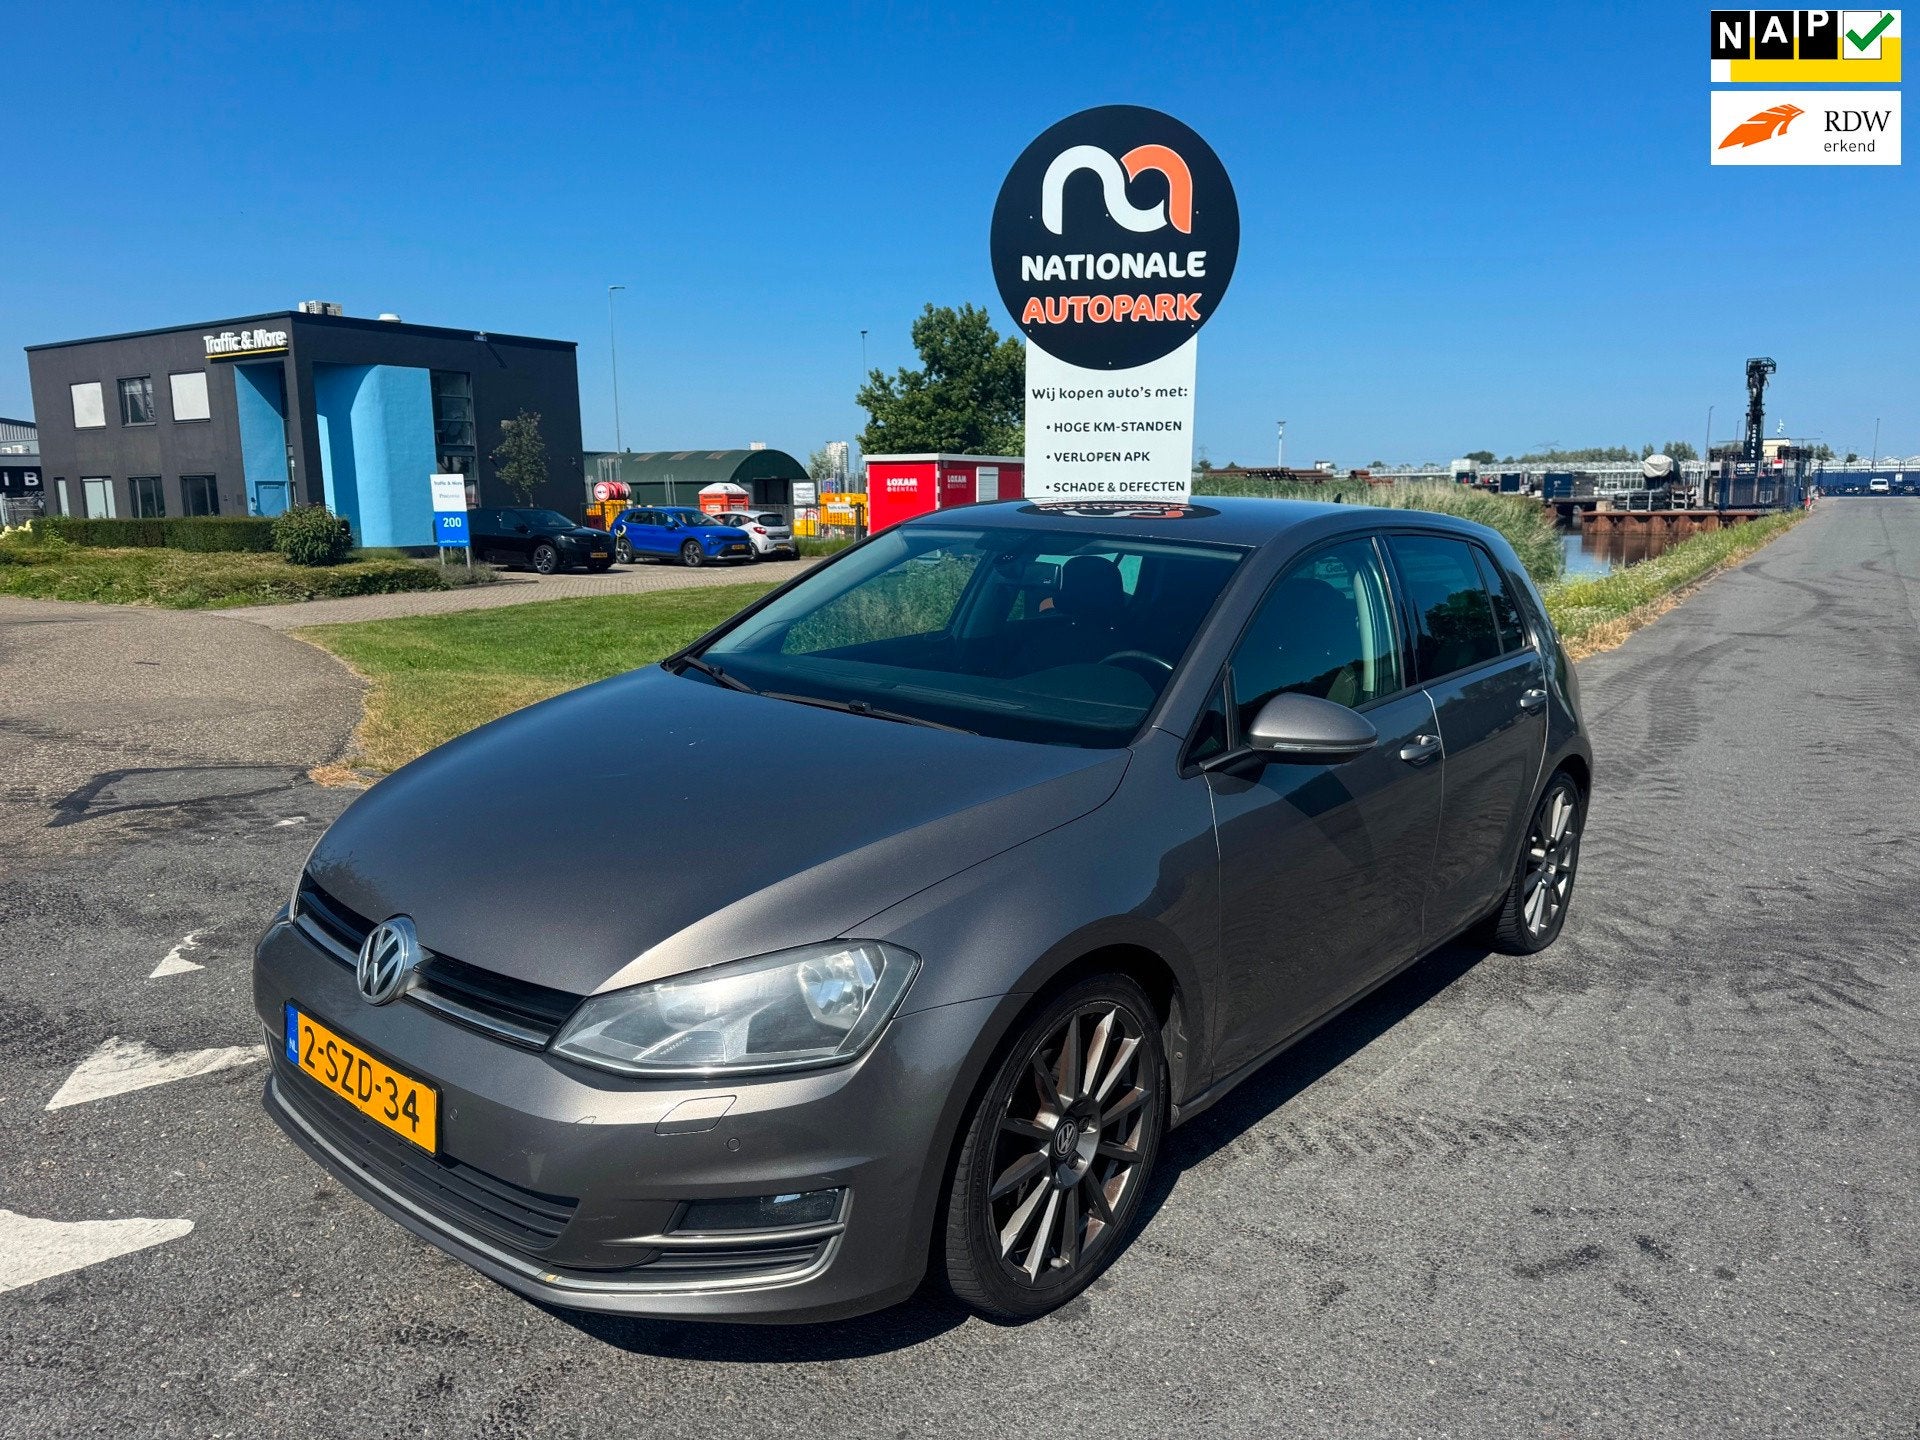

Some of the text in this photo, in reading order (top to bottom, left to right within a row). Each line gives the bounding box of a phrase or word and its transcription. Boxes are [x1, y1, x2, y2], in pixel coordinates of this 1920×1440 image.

[1022, 251, 1206, 282] NATIONALE
[1022, 293, 1203, 324] AUTOPARK
[203, 329, 287, 354] Traffic & More
[1031, 386, 1188, 401] Wij kopen auto's met:
[1053, 420, 1182, 433] HOGE KM-STANDEN
[1053, 450, 1150, 463] VERLOPEN APK
[886, 477, 918, 486] LOXAM
[947, 475, 967, 483] LOXAM
[1053, 480, 1186, 493] SCHADE & DEFECTEN
[442, 517, 462, 528] 200
[303, 1024, 420, 1134] 2-SZD-34
